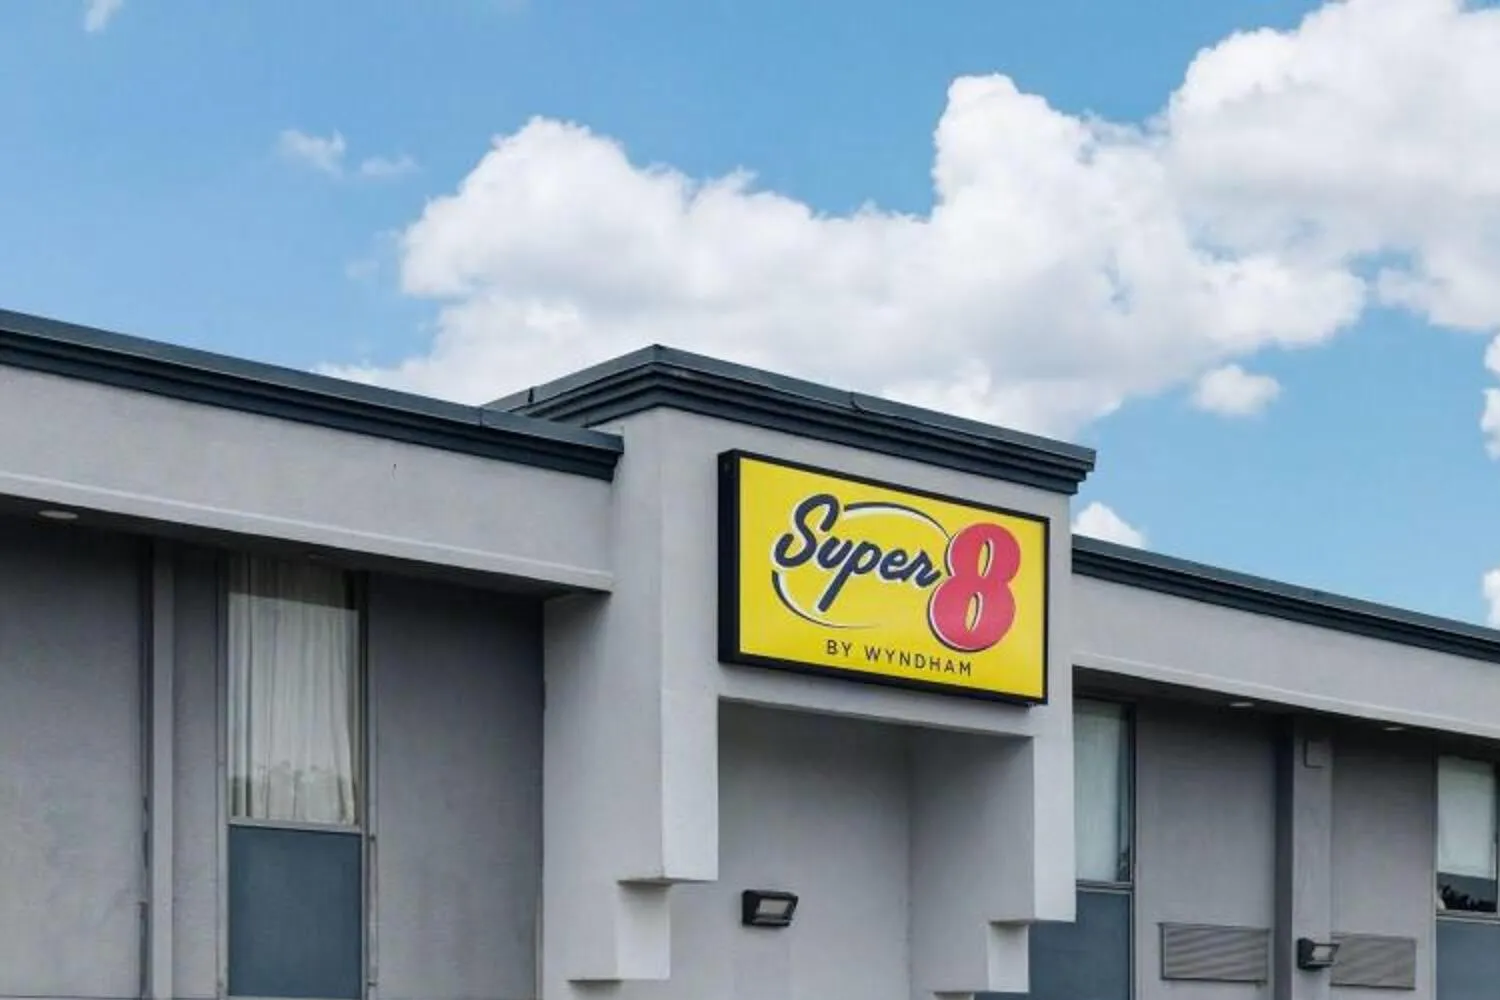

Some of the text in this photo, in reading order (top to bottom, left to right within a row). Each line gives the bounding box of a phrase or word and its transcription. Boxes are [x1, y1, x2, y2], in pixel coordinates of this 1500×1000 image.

[773, 493, 1022, 654] Super 8
[826, 639, 973, 677] BY WYNDHAM
